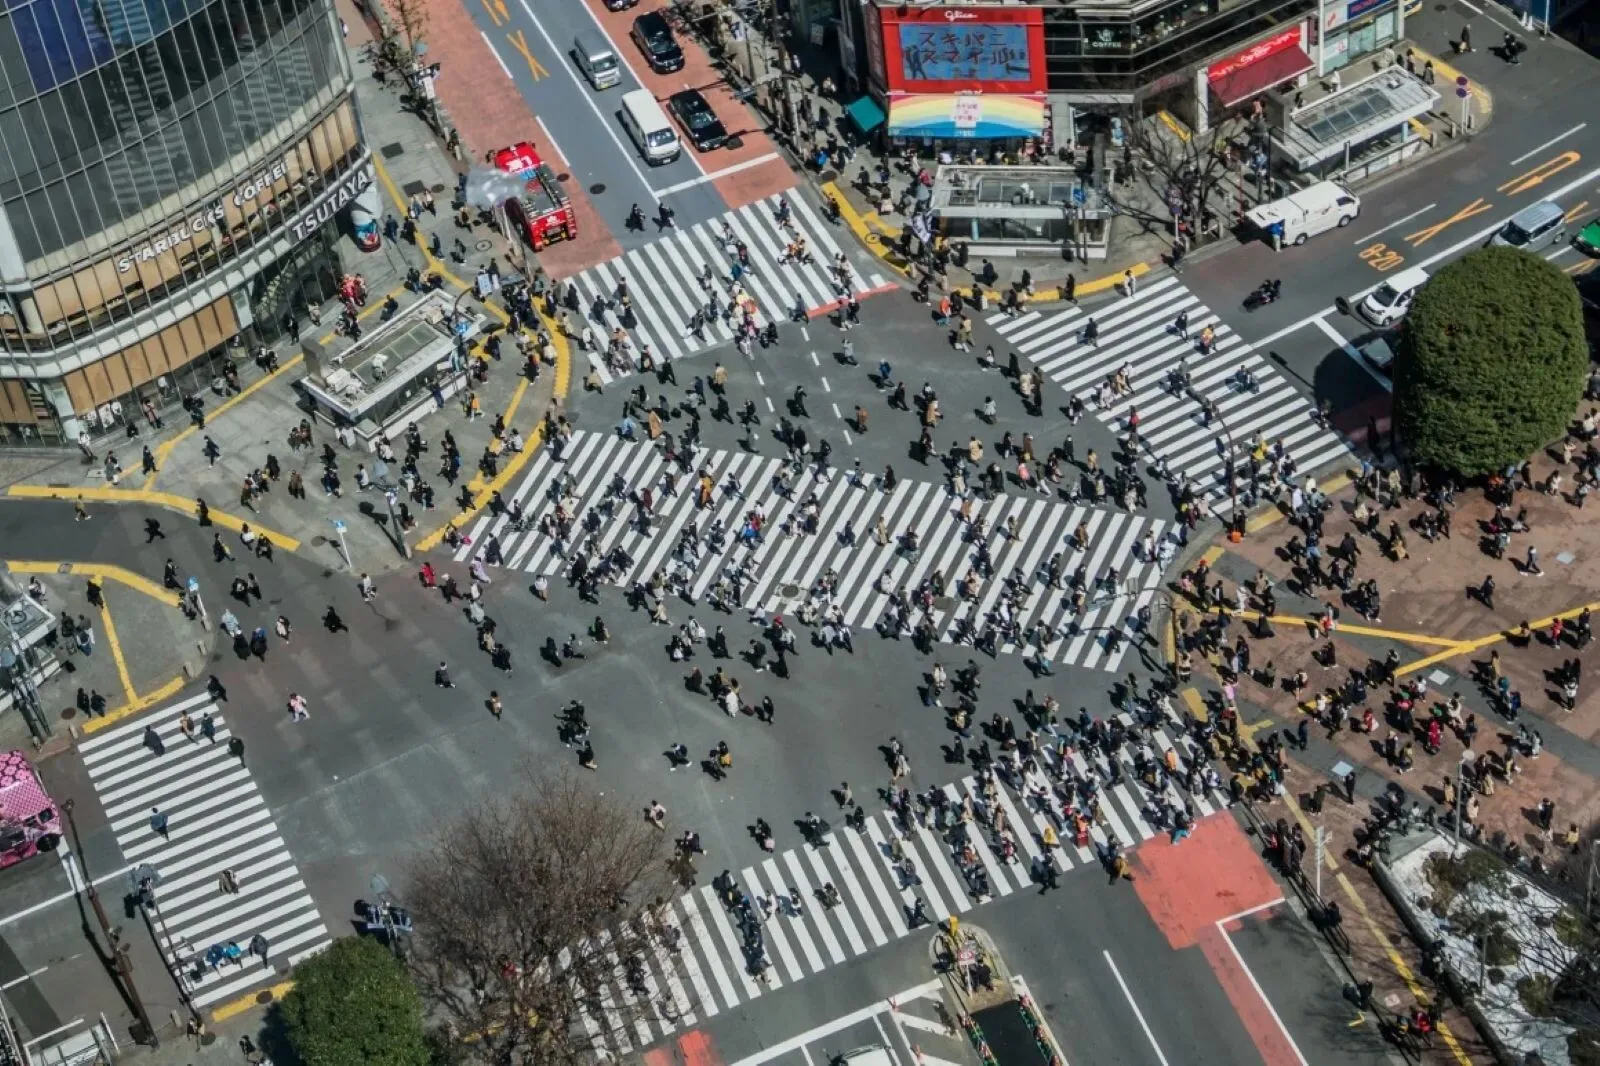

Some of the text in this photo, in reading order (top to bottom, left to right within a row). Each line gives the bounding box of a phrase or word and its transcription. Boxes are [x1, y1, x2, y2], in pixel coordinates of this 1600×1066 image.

[118, 204, 225, 273] STARBUCKS
[292, 170, 368, 240] TSUTAYA
[1358, 243, 1405, 271] 8-20
